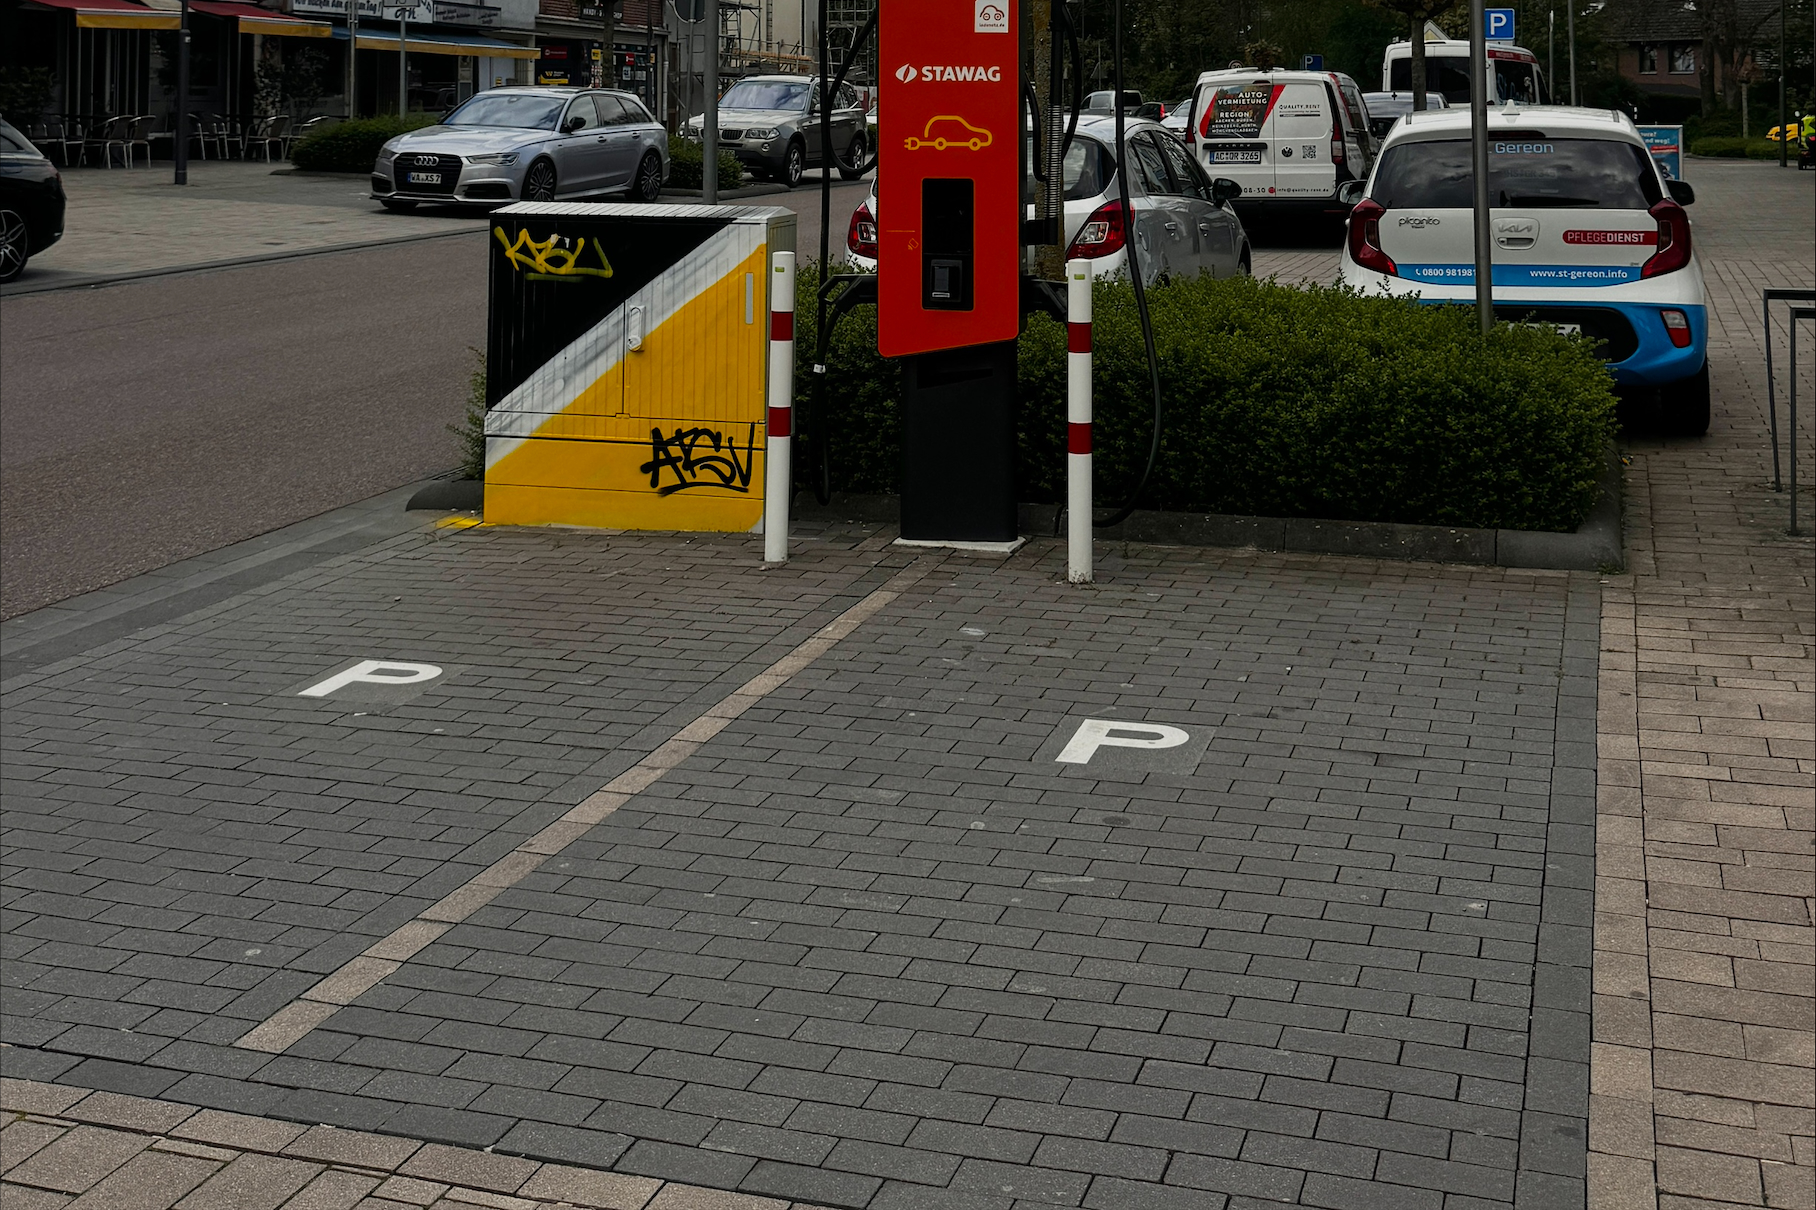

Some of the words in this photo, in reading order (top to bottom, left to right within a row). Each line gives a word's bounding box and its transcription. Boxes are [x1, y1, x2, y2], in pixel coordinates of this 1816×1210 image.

[1490, 13, 1507, 36] P
[1304, 55, 1314, 71] P
[921, 65, 1001, 82] STAWAG
[1238, 91, 1268, 99] AUTO-
[1217, 98, 1268, 106] VERMIETUNG
[1495, 142, 1554, 154] Gereon
[1215, 152, 1225, 161] AC
[1399, 216, 1440, 227] picanto
[1567, 231, 1645, 243] PFLEGEDIENST
[1422, 268, 1444, 277] 0800
[1530, 269, 1628, 280] www.st-gereon.info
[298, 659, 444, 697] P
[1055, 718, 1190, 765] P
